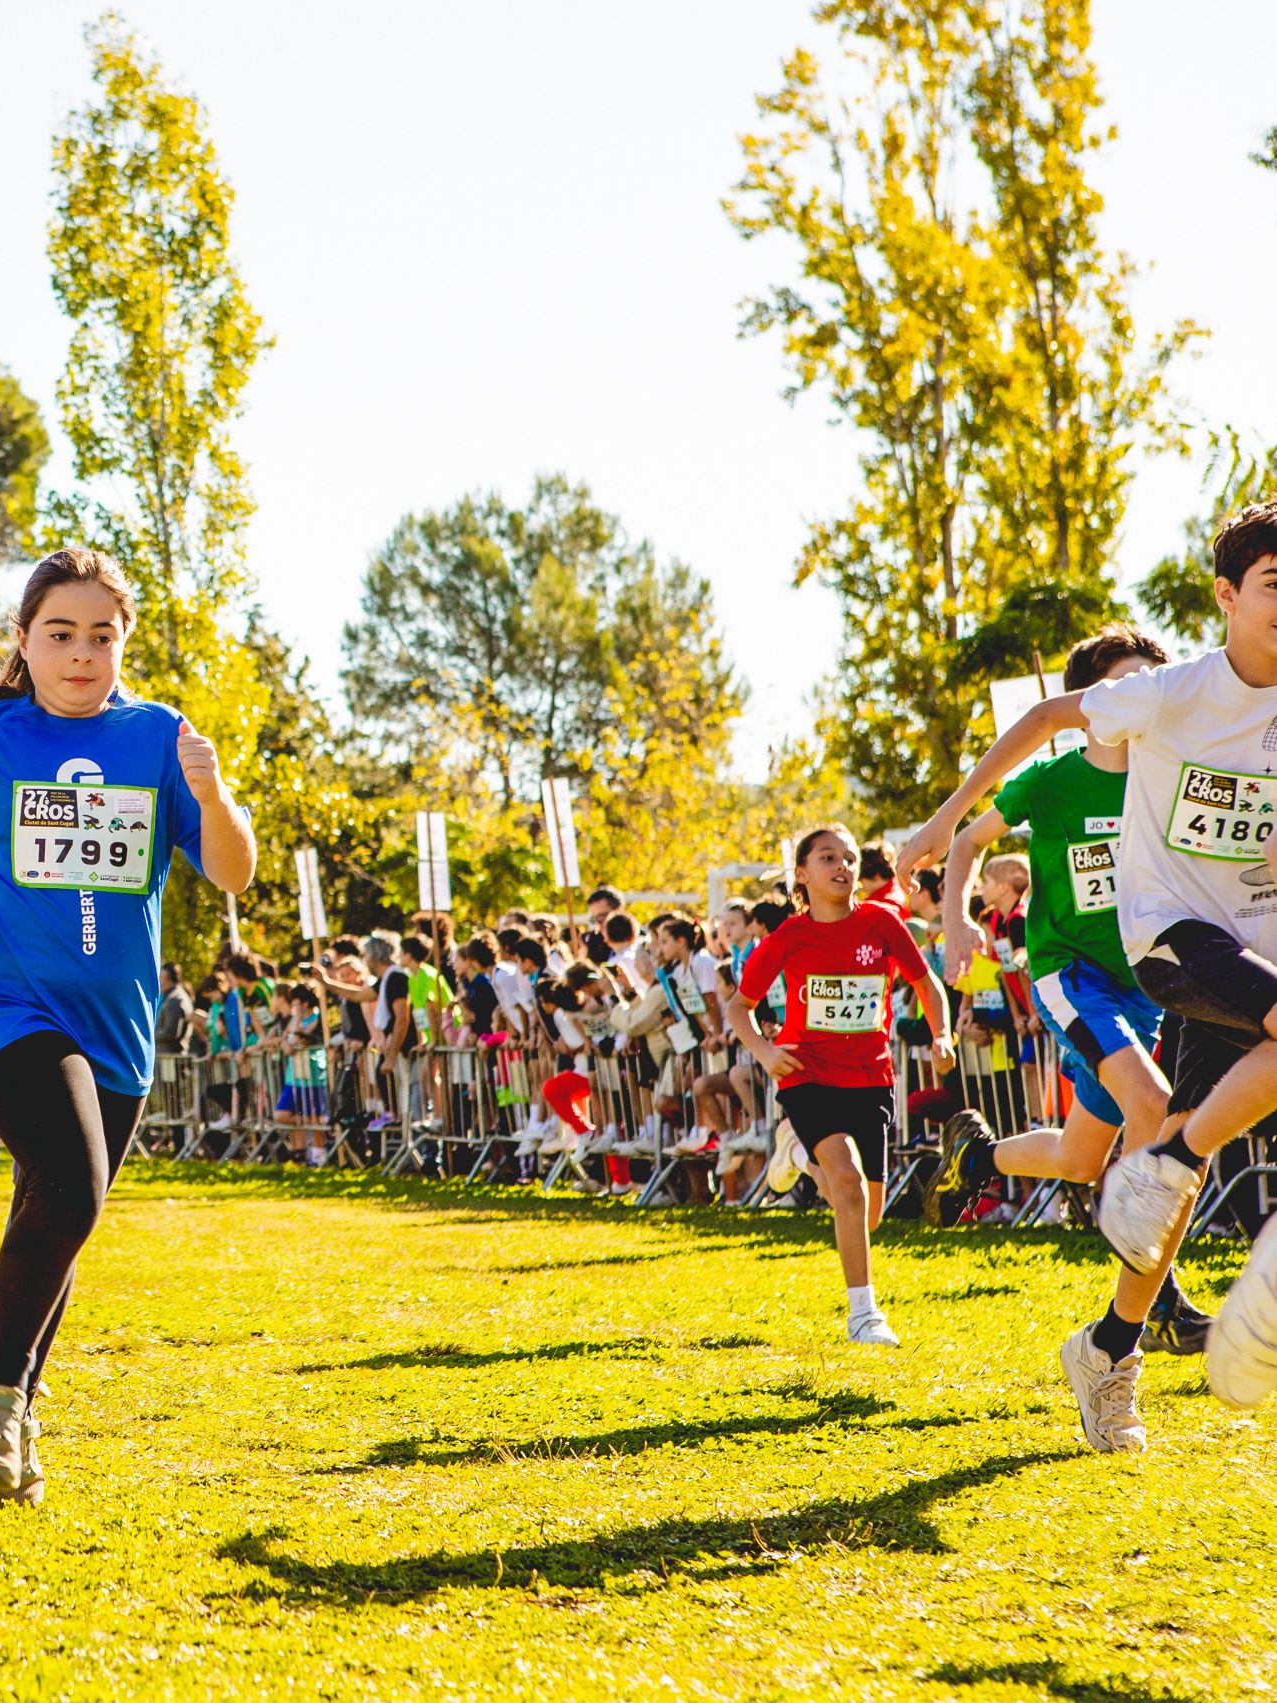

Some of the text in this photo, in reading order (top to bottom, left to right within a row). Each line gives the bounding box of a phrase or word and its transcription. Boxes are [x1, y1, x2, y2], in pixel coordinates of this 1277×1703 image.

[1187, 783, 1234, 804] CROS
[23, 804, 75, 820] CROS
[1089, 821, 1103, 830] JO
[1188, 814, 1274, 843] 4180
[34, 838, 128, 867] 1799
[1075, 853, 1112, 869] CROS
[79, 889, 97, 956] GERBERT
[813, 986, 841, 997] CROS
[825, 1006, 865, 1019] 547
